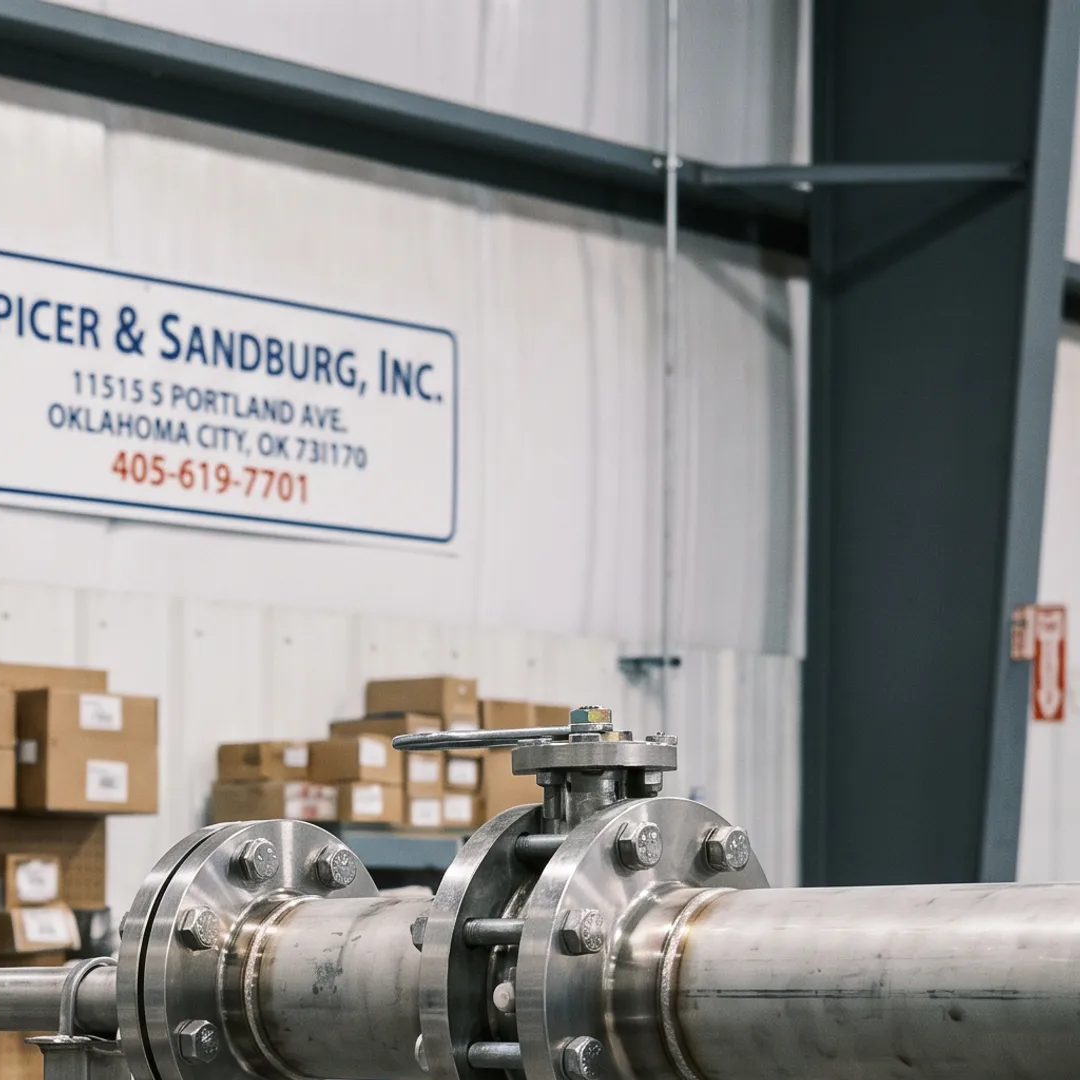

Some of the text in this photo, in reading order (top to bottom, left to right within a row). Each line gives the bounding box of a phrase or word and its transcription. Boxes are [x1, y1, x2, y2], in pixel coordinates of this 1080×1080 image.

[115, 305, 145, 356] &
[160, 314, 366, 397] SANDBURG,
[380, 349, 444, 403] INC.
[48, 403, 190, 446] OKLAHOMA
[197, 423, 251, 457] CITY,
[257, 432, 290, 460] OK
[73, 370, 143, 403] 11515
[171, 384, 295, 425] PORTLAND
[300, 404, 348, 433] AVE.
[111, 450, 309, 503] 405-619-7701
